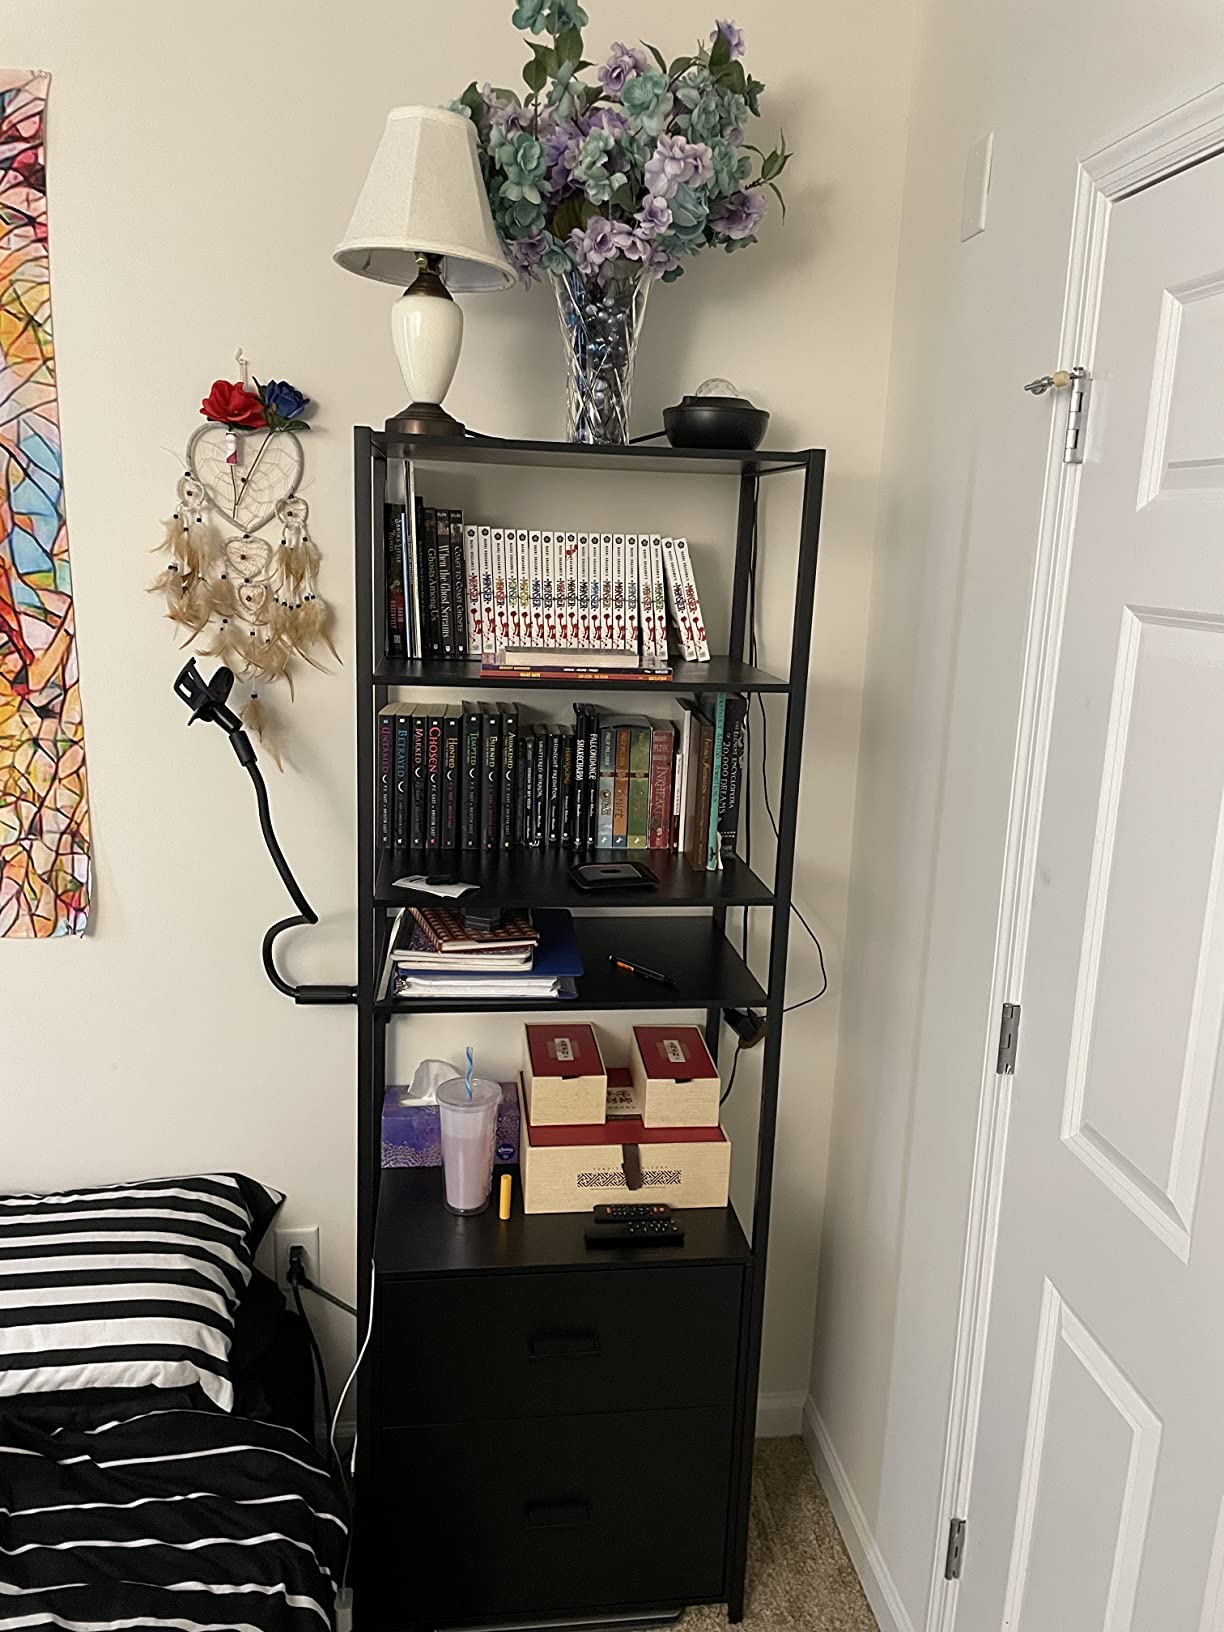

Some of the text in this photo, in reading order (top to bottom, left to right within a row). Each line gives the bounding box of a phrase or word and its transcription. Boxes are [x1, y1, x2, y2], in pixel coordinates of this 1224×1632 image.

[427, 548, 439, 622] Ghosts Among Us
[438, 544, 452, 638] When the Ghost Screams
[381, 726, 391, 773] UNTAMED
[397, 730, 408, 777] BETRAYED
[414, 728, 423, 764] MARKED
[428, 726, 442, 774] CHOSEN
[470, 732, 480, 766] TEMPTED
[489, 735, 498, 768] BURNED
[506, 732, 517, 769] AWAKENED
[721, 741, 730, 777] 20,000
[655, 765, 668, 817] INKHEART
[718, 778, 728, 814] DREAMS
[728, 757, 739, 809] ENCYCLOPEDIA
